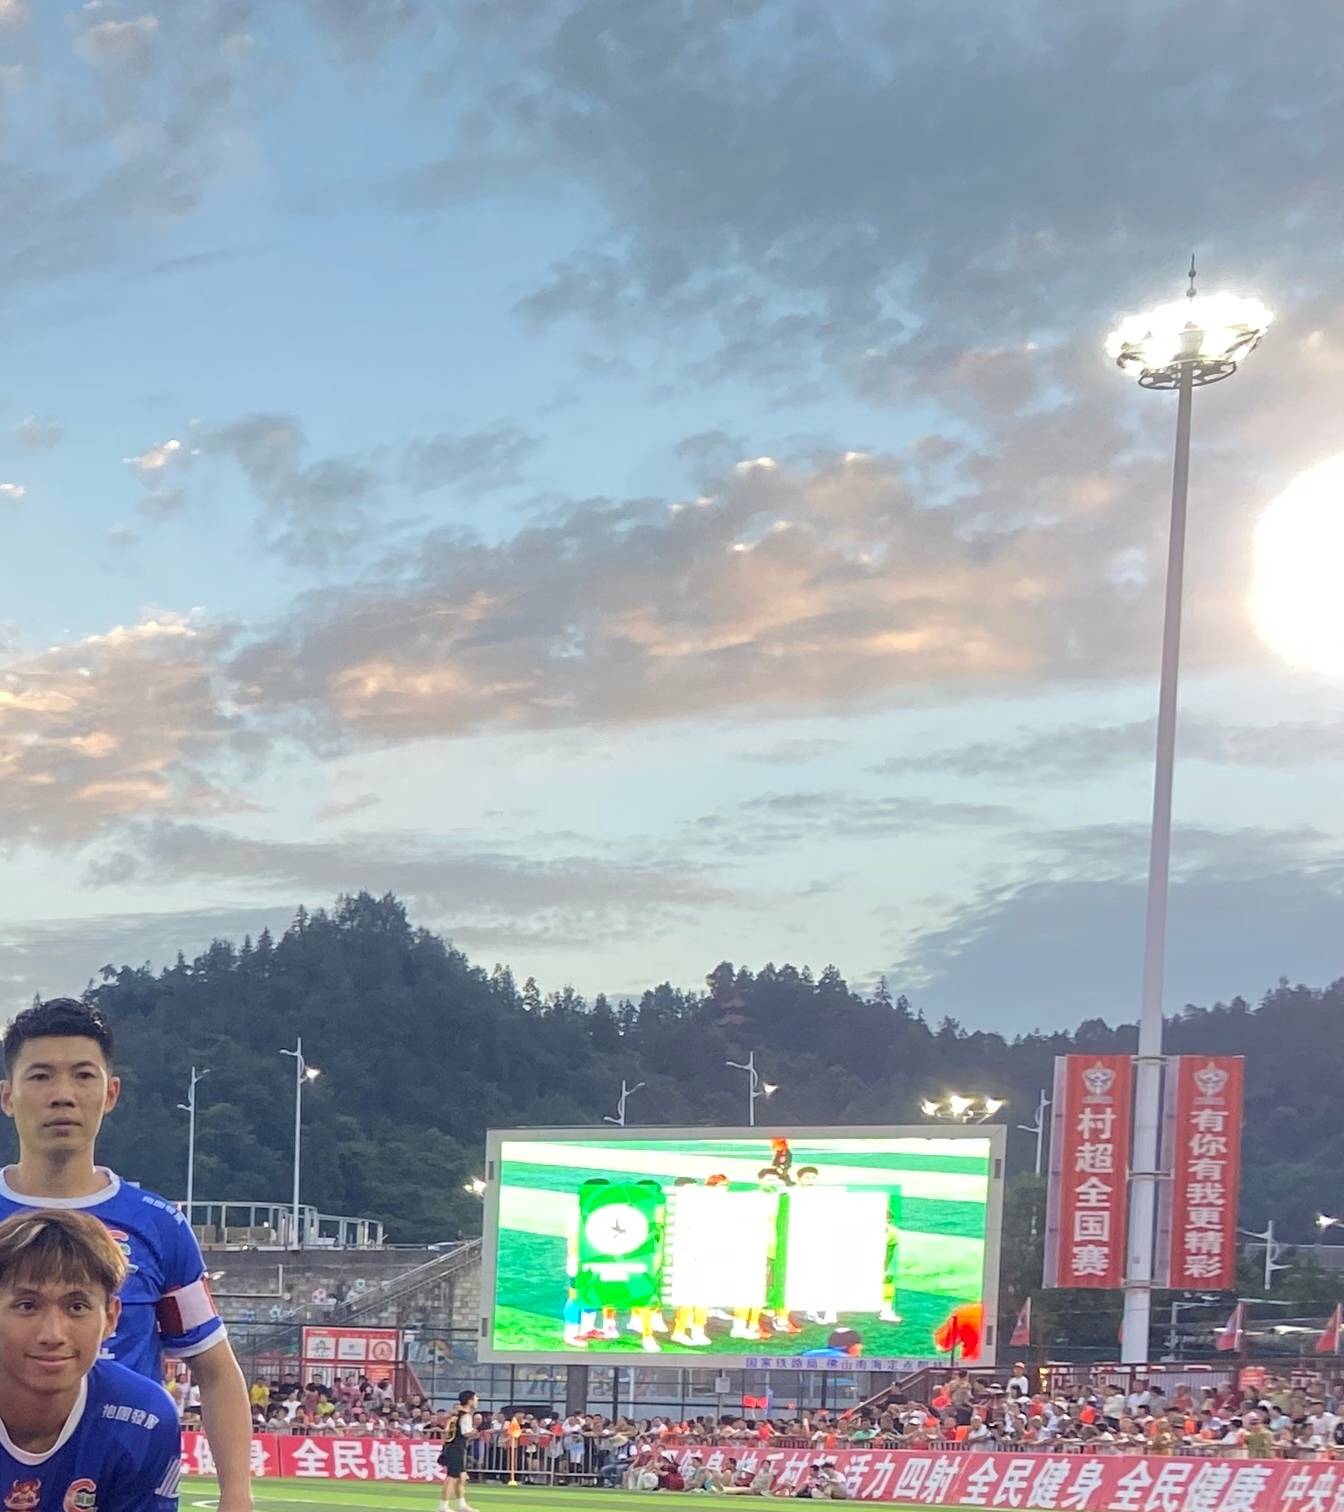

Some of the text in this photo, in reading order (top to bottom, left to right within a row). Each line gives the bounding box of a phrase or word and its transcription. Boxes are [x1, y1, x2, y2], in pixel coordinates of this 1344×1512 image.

[1072, 1107, 1117, 1276] 村超全国赛
[1184, 1108, 1229, 1278] 有你有我更精彩
[292, 1438, 447, 1482] 全民健康
[844, 1453, 958, 1505] 活力四射
[960, 1457, 1105, 1512] 全民健身
